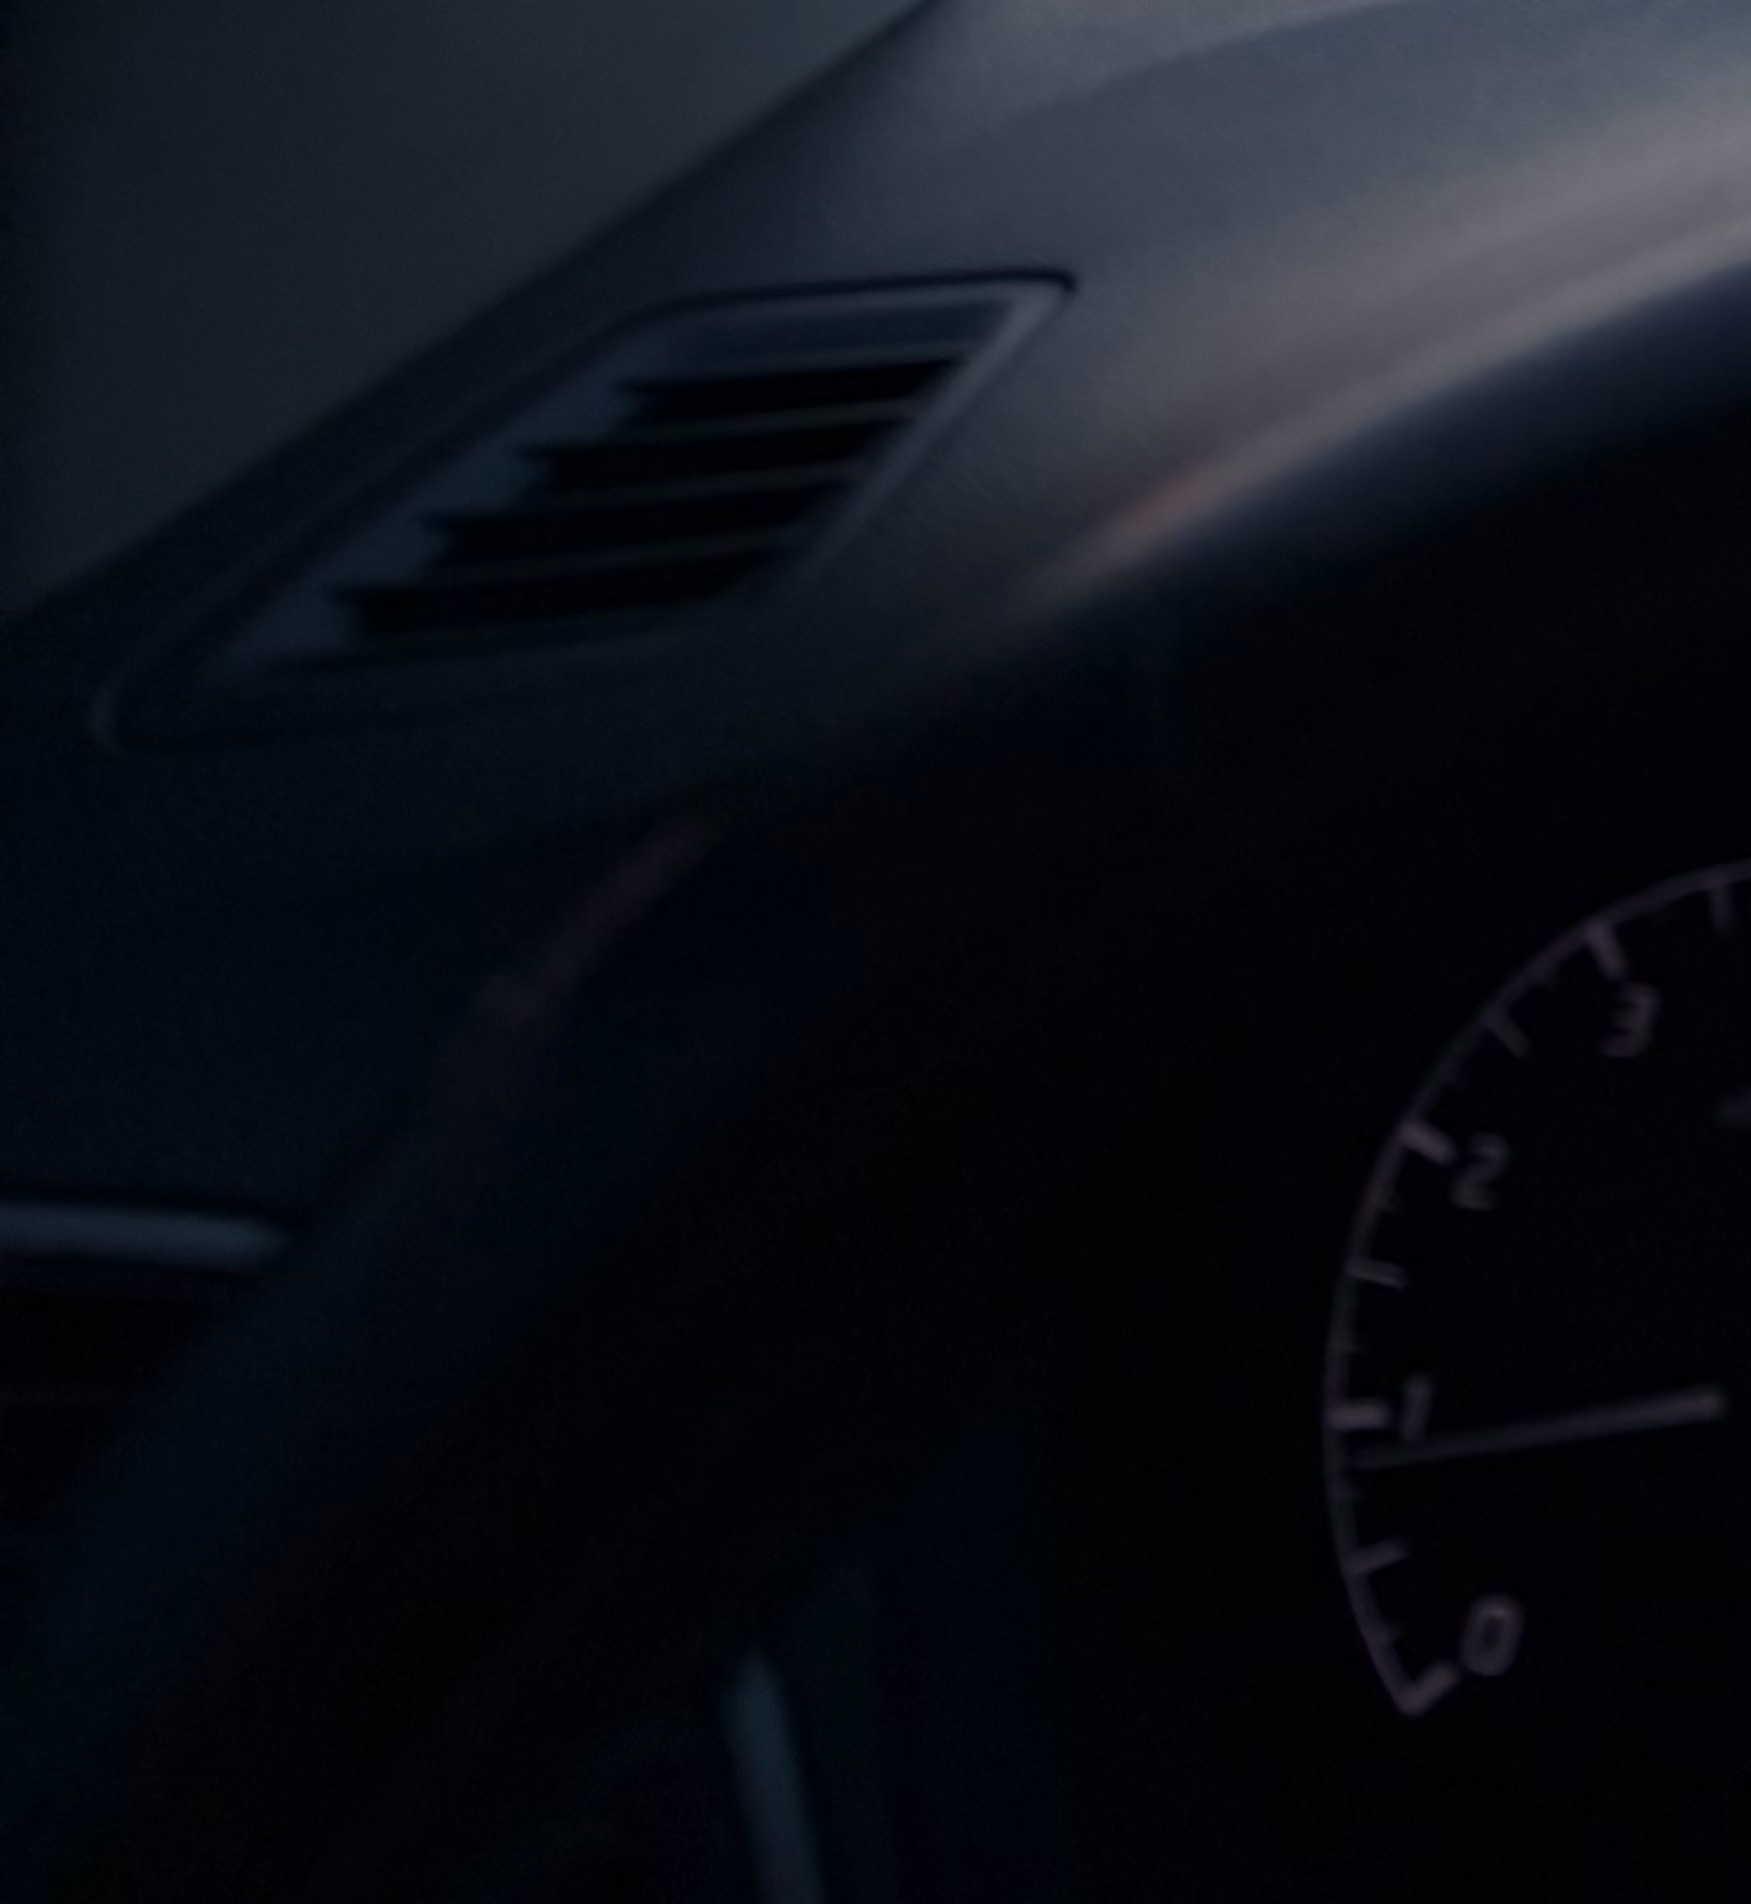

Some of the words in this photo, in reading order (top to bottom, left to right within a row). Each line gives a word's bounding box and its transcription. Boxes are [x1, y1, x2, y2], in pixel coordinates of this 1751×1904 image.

[1600, 980, 1661, 1059] 3
[1450, 1134, 1511, 1212] 2
[1460, 1594, 1526, 1677] 0
